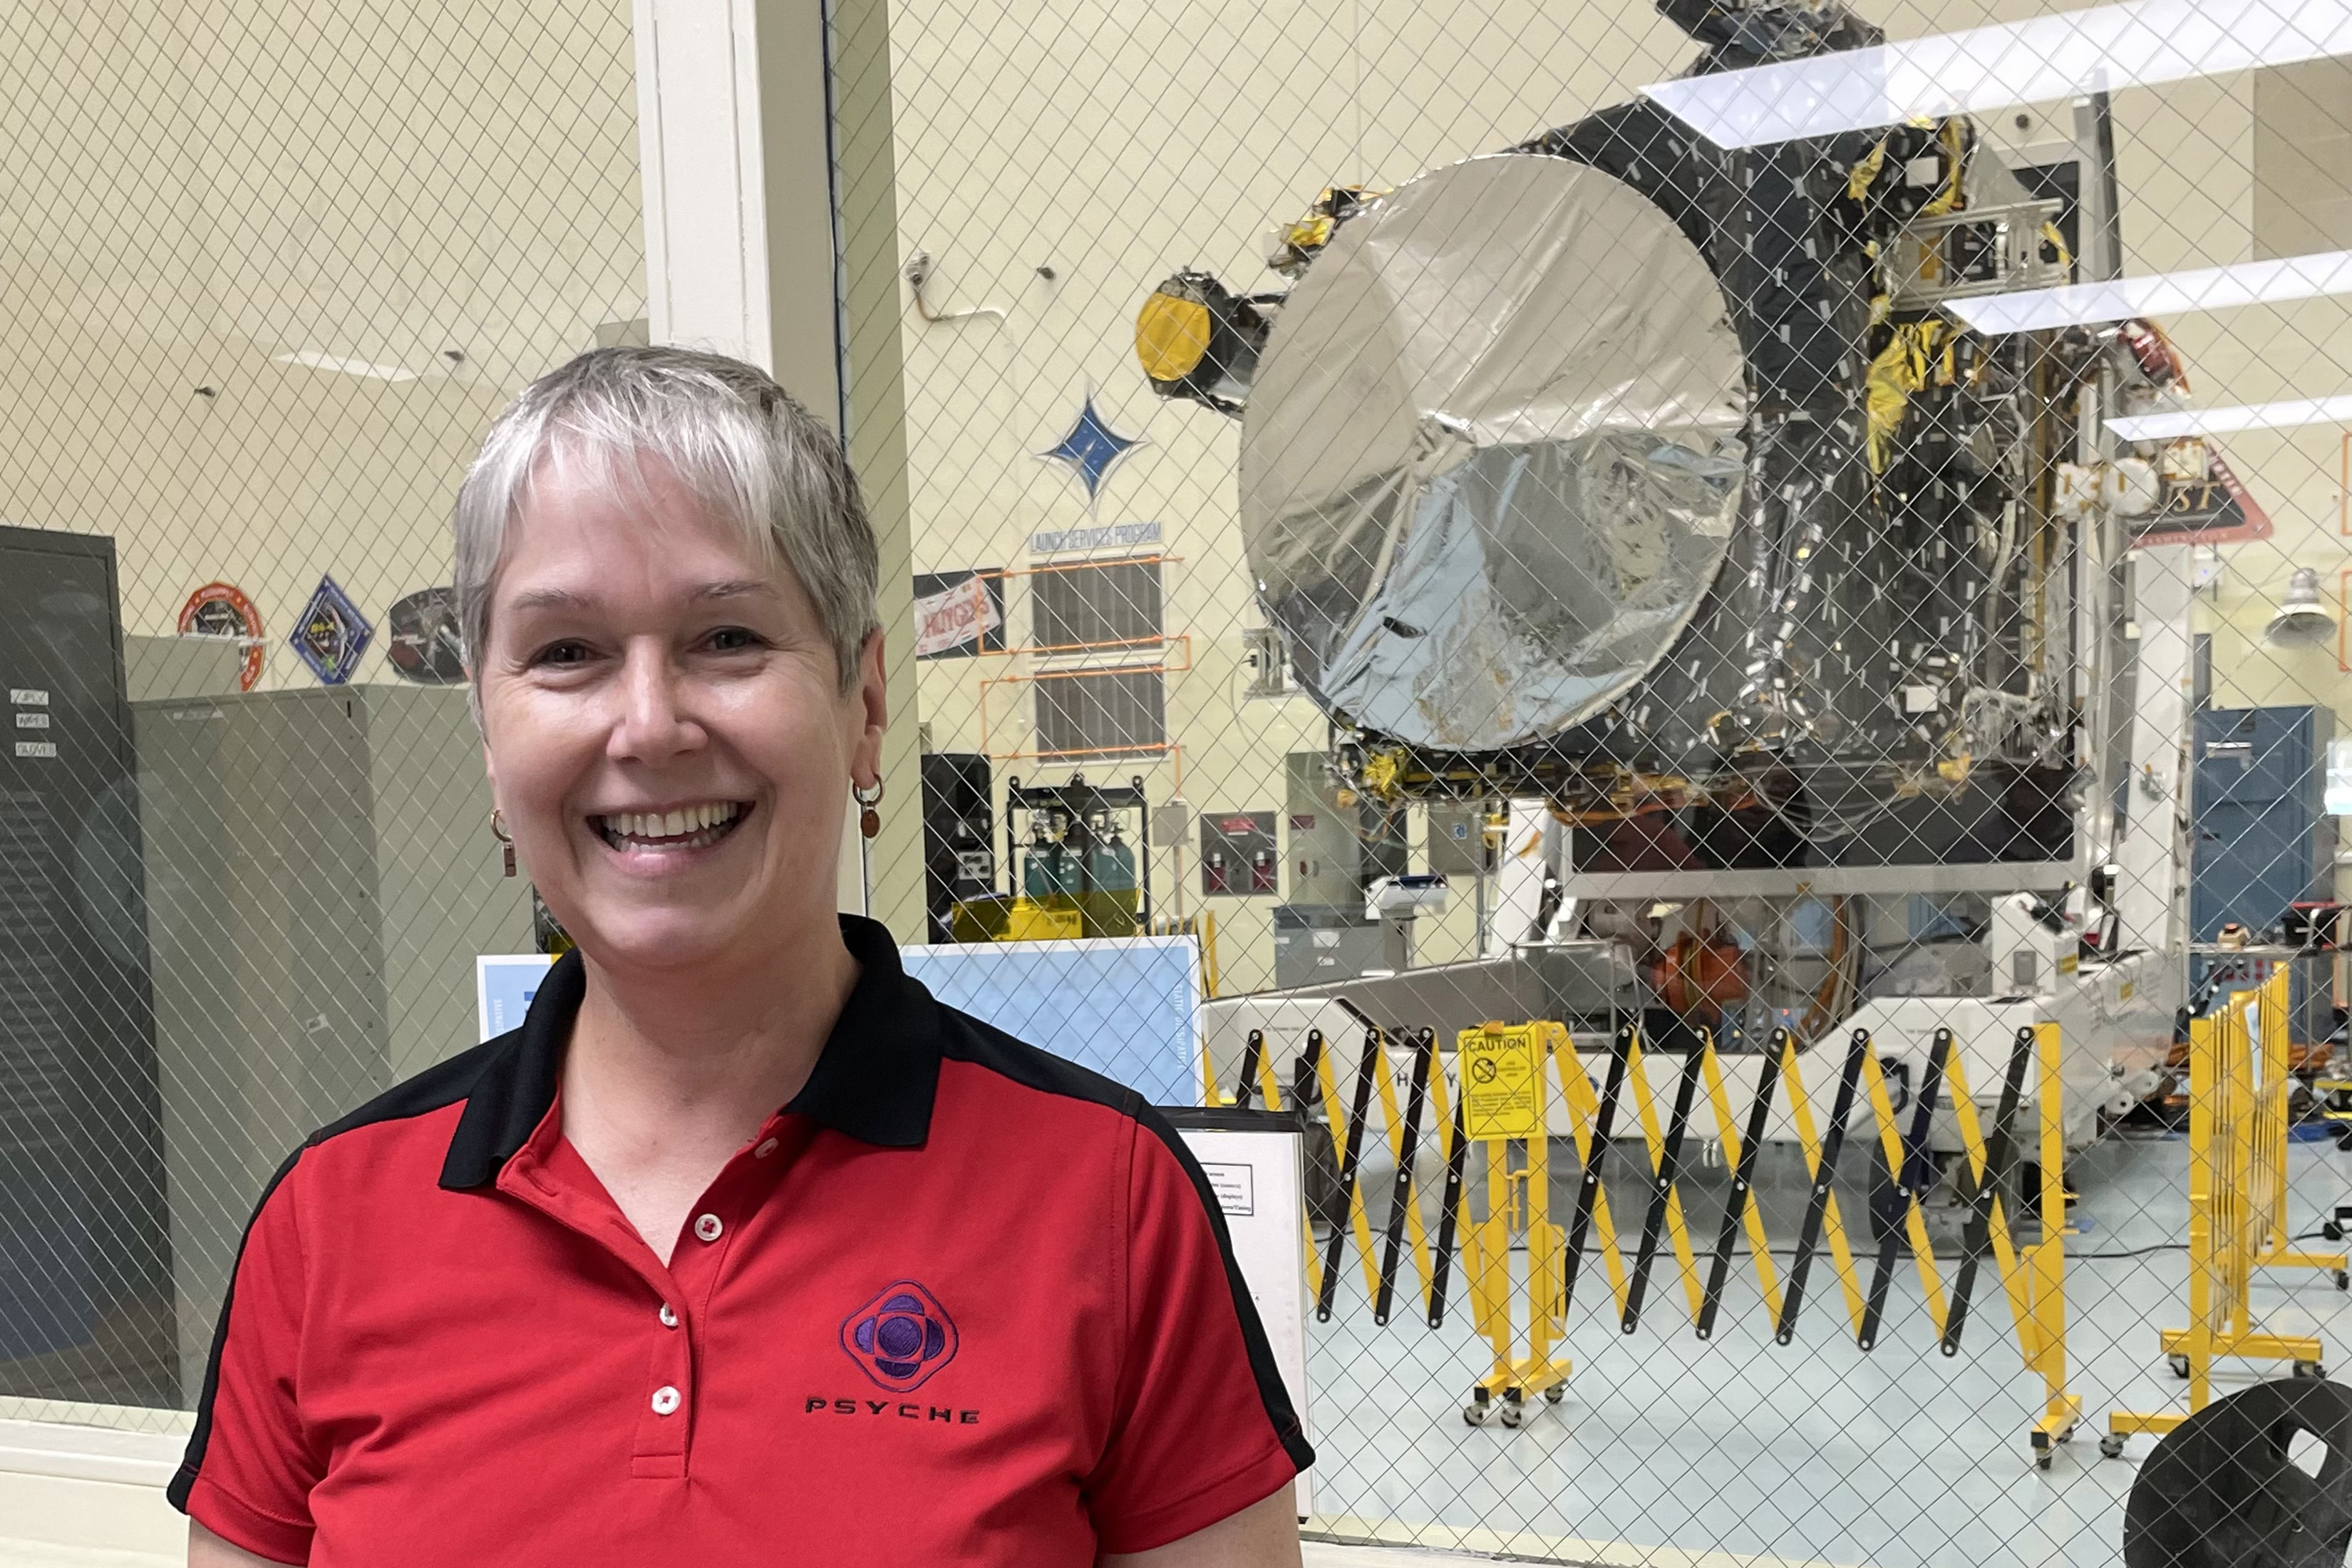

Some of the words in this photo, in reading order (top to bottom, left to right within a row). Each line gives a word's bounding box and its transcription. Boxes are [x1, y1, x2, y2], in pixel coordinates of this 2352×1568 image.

[1031, 531, 1068, 552] LAUNCH
[1069, 527, 1112, 548] SERVICES
[1115, 522, 1161, 544] PROGRAM
[1172, 984, 1185, 1013] STATIC
[1175, 1016, 1187, 1070] DISSIPATIVE
[1468, 1038, 1526, 1053] CAUTION
[805, 1397, 980, 1423] PSYCHE
